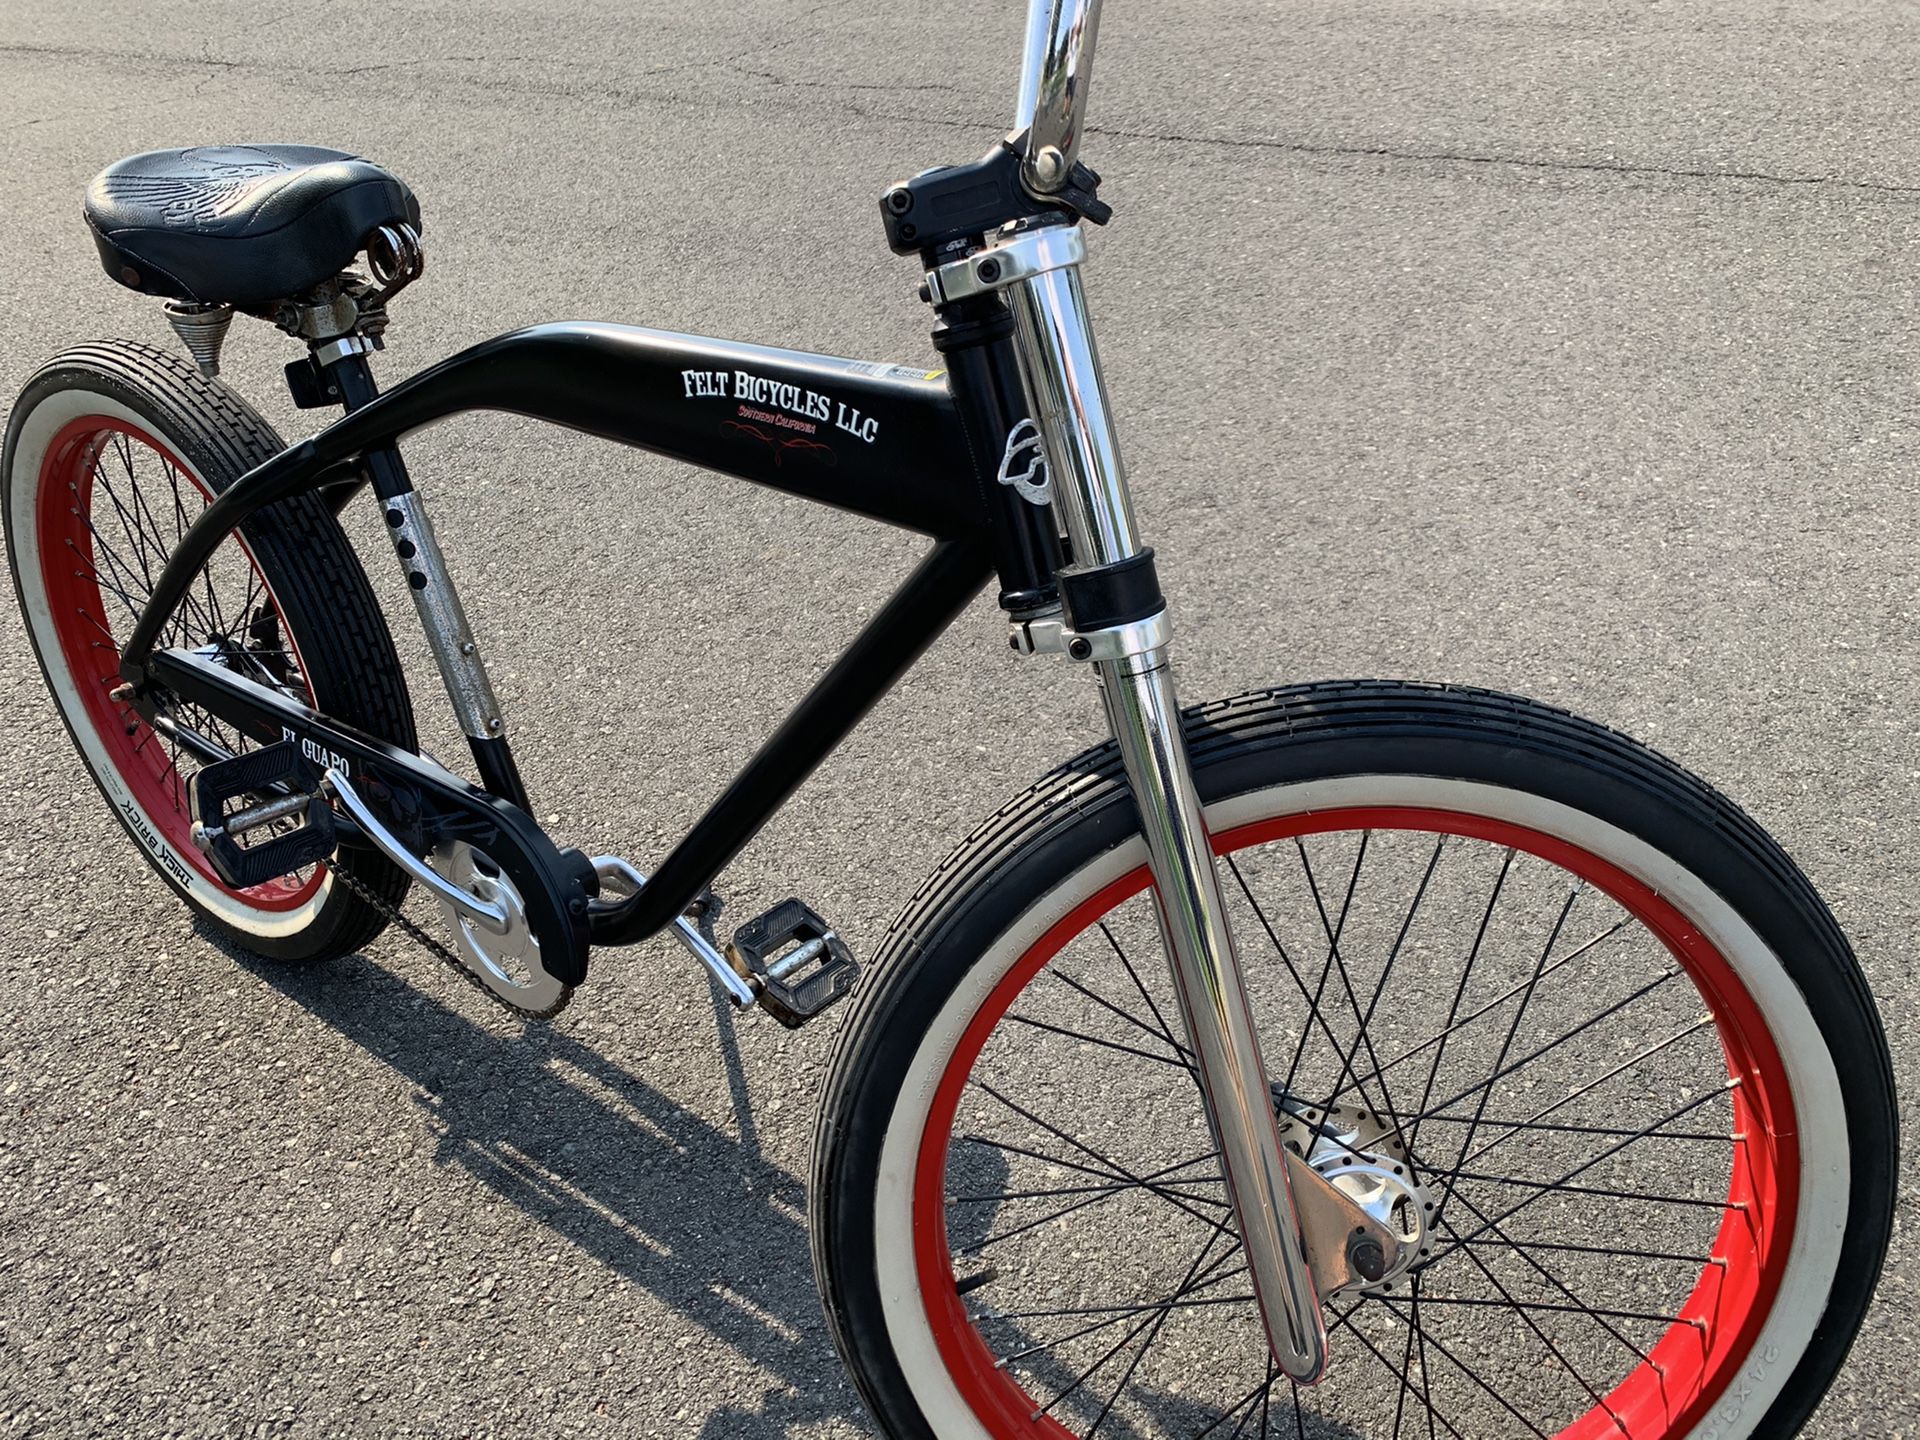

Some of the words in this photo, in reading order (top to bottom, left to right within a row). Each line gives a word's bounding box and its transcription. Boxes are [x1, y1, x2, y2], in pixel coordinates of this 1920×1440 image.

[681, 369, 729, 398] FELT
[734, 370, 831, 423] BICYCLES
[834, 402, 879, 444] LLC
[775, 412, 817, 435] CALIFORNIA
[301, 738, 351, 778] GUAPO
[120, 800, 160, 852] BRICK
[158, 844, 194, 889] THICK
